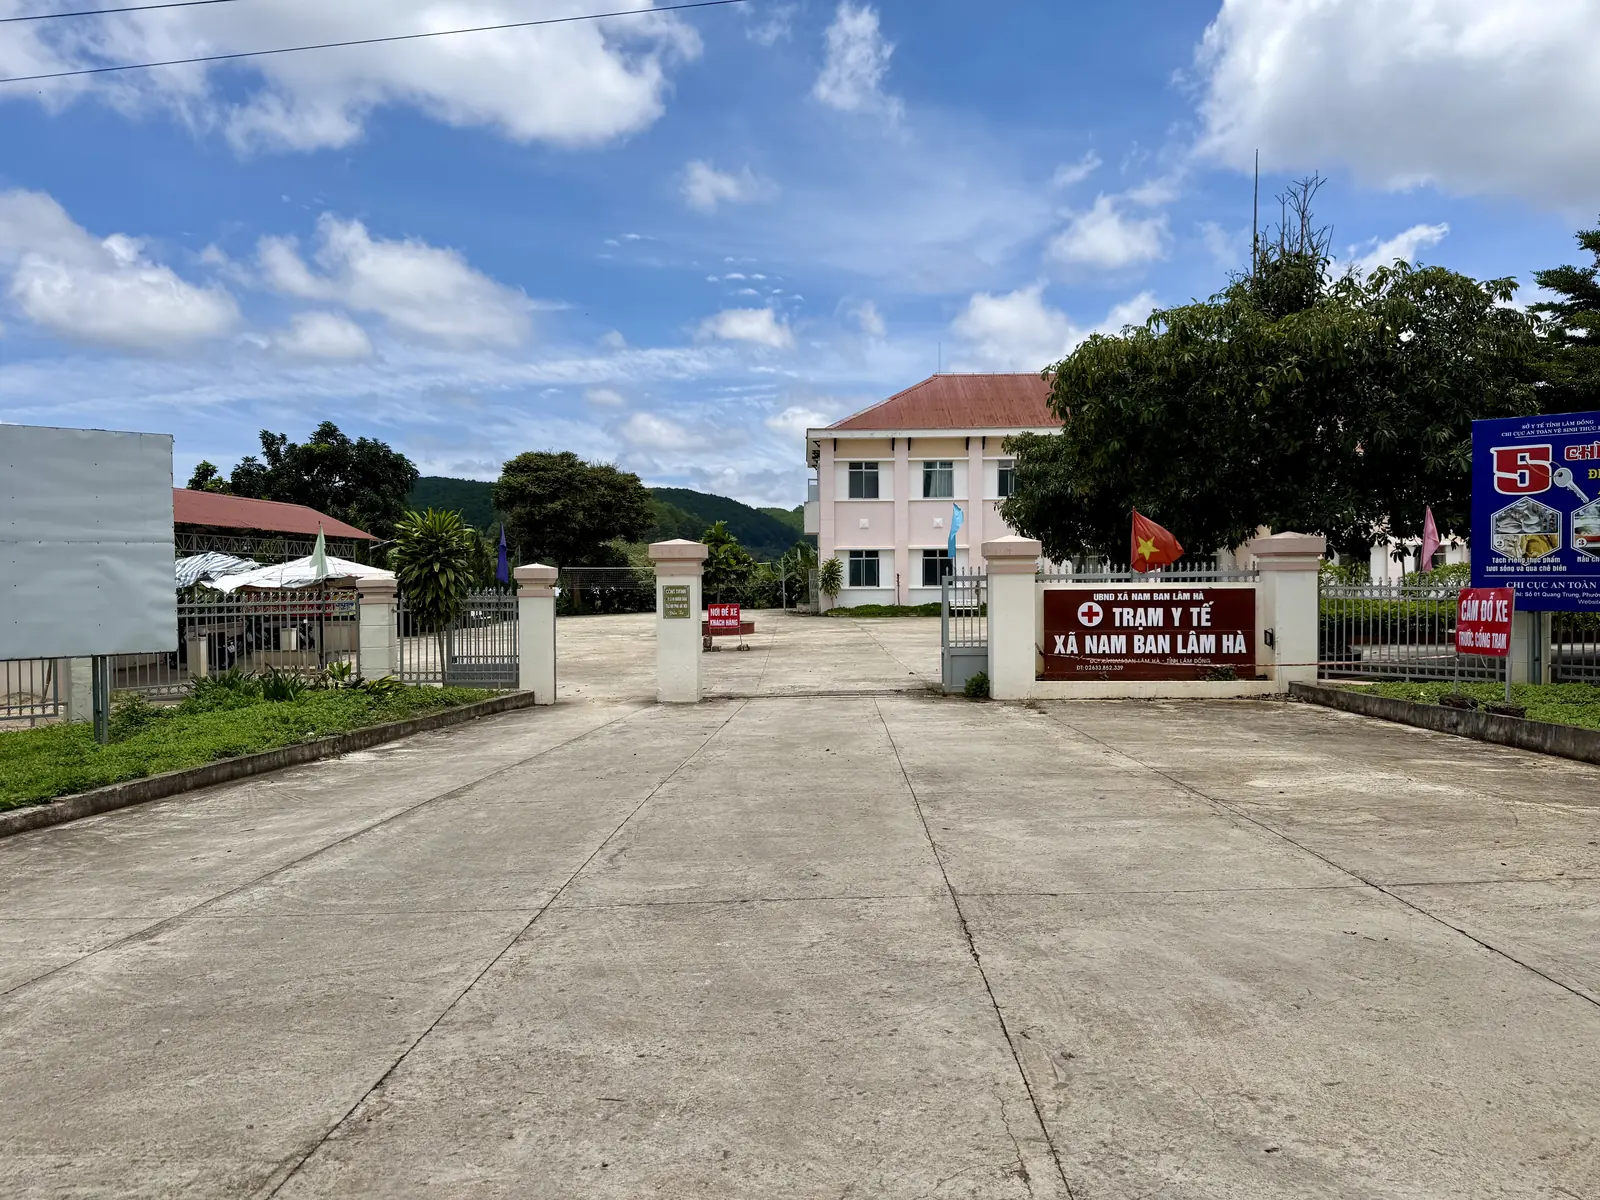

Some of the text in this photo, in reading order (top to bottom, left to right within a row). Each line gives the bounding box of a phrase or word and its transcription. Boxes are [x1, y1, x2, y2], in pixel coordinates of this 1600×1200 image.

[1490, 444, 1552, 495] 5
[1093, 591, 1204, 601] UBND XÃ NAM BAN LÂM HÀ
[1526, 582, 1548, 590] CỤC
[1568, 580, 1597, 588] TOÀN
[710, 604, 738, 616] NƠI ĐỂ XE
[1112, 601, 1214, 630] TRẠM Y TẾ
[1461, 592, 1508, 622] CẤM ĐỖ XE
[710, 618, 738, 626] KHÁCH HÀNG
[1054, 630, 1247, 654] XÃ NAM BAN LÂM HÀ
[1474, 626, 1490, 648] CỔNG
[1492, 632, 1507, 652] TRẠM
